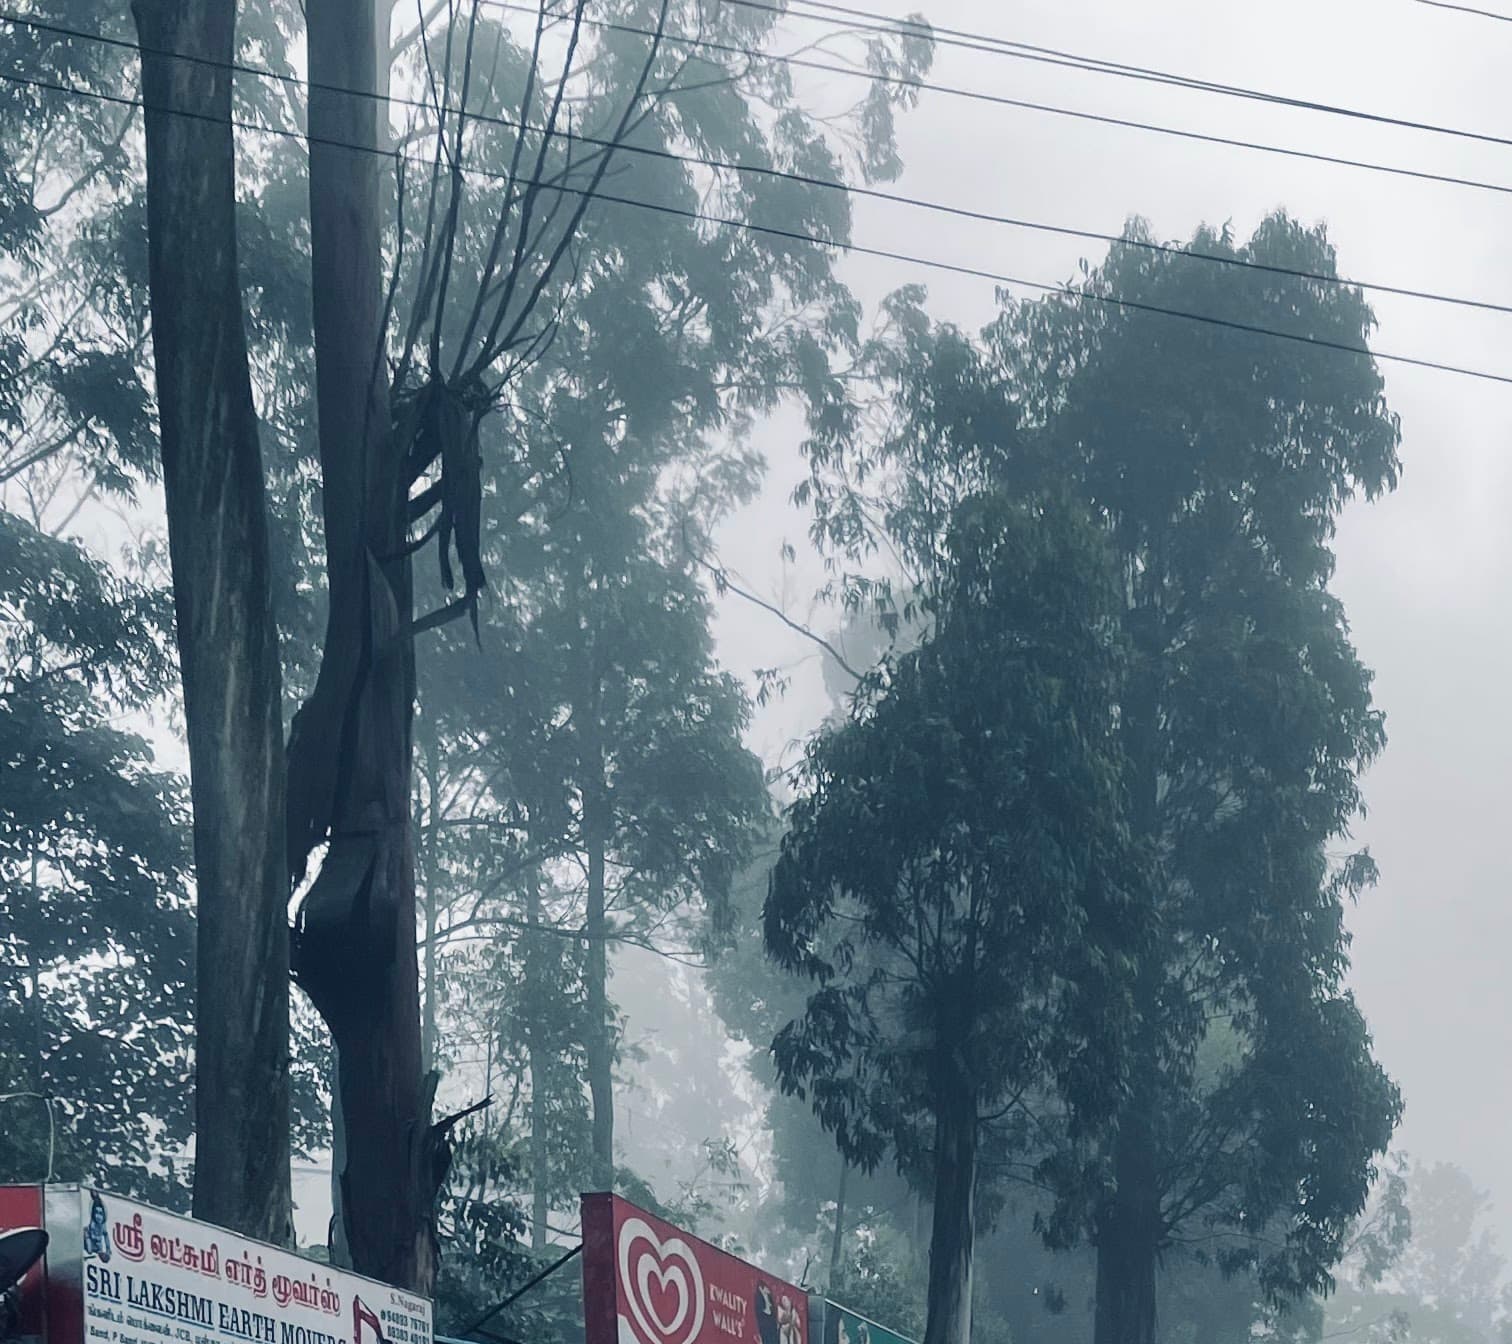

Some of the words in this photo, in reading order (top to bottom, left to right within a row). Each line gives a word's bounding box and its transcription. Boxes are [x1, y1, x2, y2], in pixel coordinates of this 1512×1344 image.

[225, 1251, 267, 1297] எர்த்
[87, 1264, 121, 1301] SRI
[127, 1275, 214, 1327] LAKSHMI
[219, 1302, 276, 1344] EARTH
[709, 1283, 747, 1316] KWALITY
[712, 1310, 743, 1338] WALL'S
